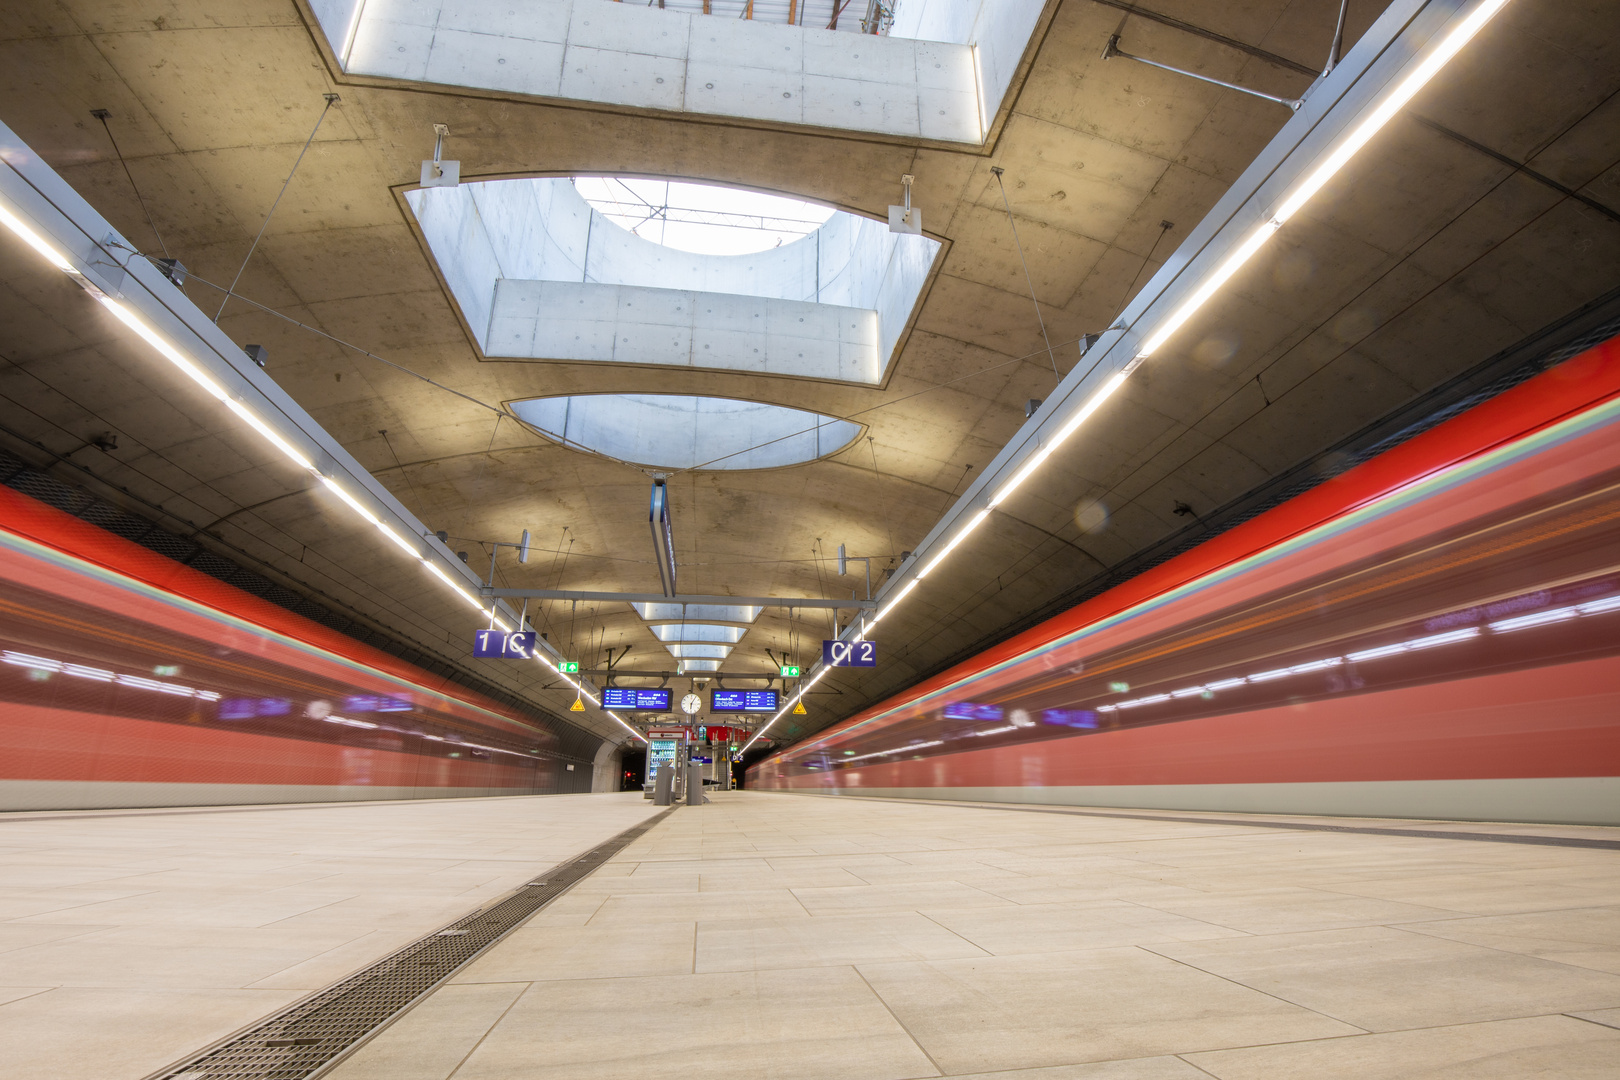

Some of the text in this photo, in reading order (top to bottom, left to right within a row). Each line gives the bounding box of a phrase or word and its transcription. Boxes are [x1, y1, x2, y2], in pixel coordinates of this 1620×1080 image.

[480, 632, 526, 653] 1 C
[831, 642, 873, 661] C 2
